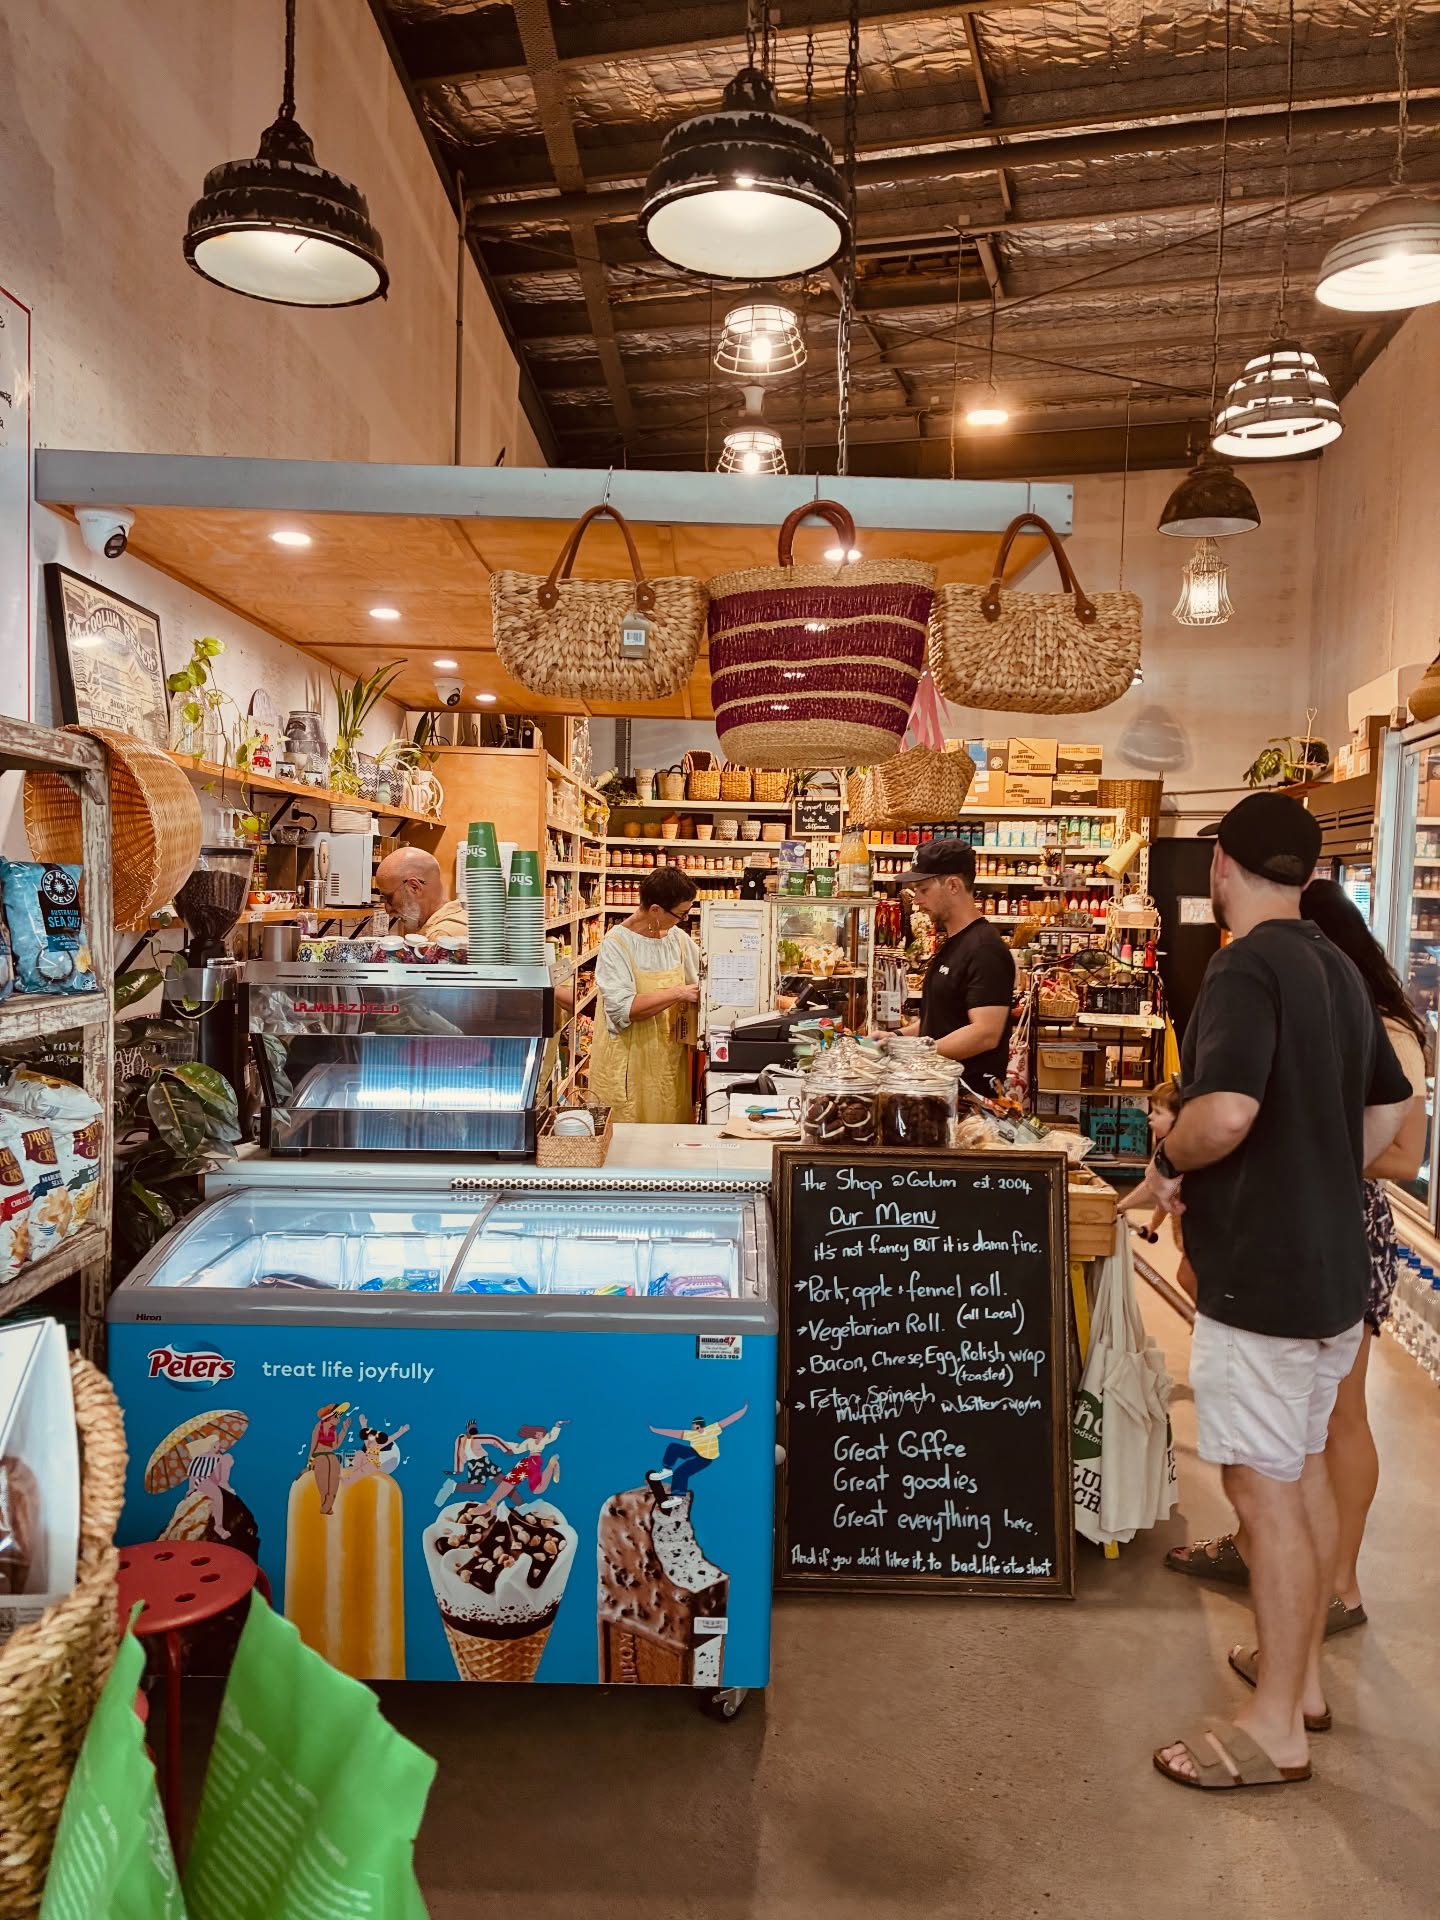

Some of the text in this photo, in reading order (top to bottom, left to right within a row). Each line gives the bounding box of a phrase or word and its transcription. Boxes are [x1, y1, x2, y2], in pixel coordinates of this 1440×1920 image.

[44, 871, 76, 892] RED ROCK
[51, 891, 73, 903] DELI
[47, 916, 67, 928] SEA
[801, 1169, 827, 1191] the
[837, 1168, 882, 1199] Shop
[973, 1174, 994, 1190] est.
[998, 1178, 1033, 1195] 2004
[830, 1202, 937, 1226] Our Menu
[842, 1240, 864, 1257] not
[868, 1234, 910, 1262] fancy
[913, 1236, 941, 1252] BUT
[943, 1235, 955, 1253] it
[956, 1236, 969, 1251] is
[972, 1229, 1009, 1251] damn
[1012, 1230, 1043, 1255] fine.
[808, 1275, 851, 1304] Pork,
[852, 1274, 893, 1311] apple
[905, 1270, 962, 1302] fennel
[969, 1271, 1008, 1297] roll.
[136, 1313, 162, 1321] Hiron
[957, 1302, 980, 1329] (all
[808, 1314, 900, 1351] Vegetarian
[148, 1348, 236, 1379] Peters
[262, 1360, 435, 1384] treat life joyfully
[809, 1354, 867, 1374] Bacon,
[960, 1340, 1005, 1363] Relish
[1009, 1348, 1046, 1377] wrap
[955, 1363, 1014, 1387] (toasted)
[867, 1382, 936, 1404] Spinach
[834, 1433, 890, 1462] Great
[833, 1463, 978, 1500] Great goodies
[833, 1499, 1039, 1549] Great everything here.
[791, 1544, 816, 1565] And
[819, 1547, 831, 1567] if
[832, 1555, 853, 1572] you
[885, 1550, 910, 1568] like
[926, 1551, 942, 1571] to
[1026, 1556, 1053, 1577] short
